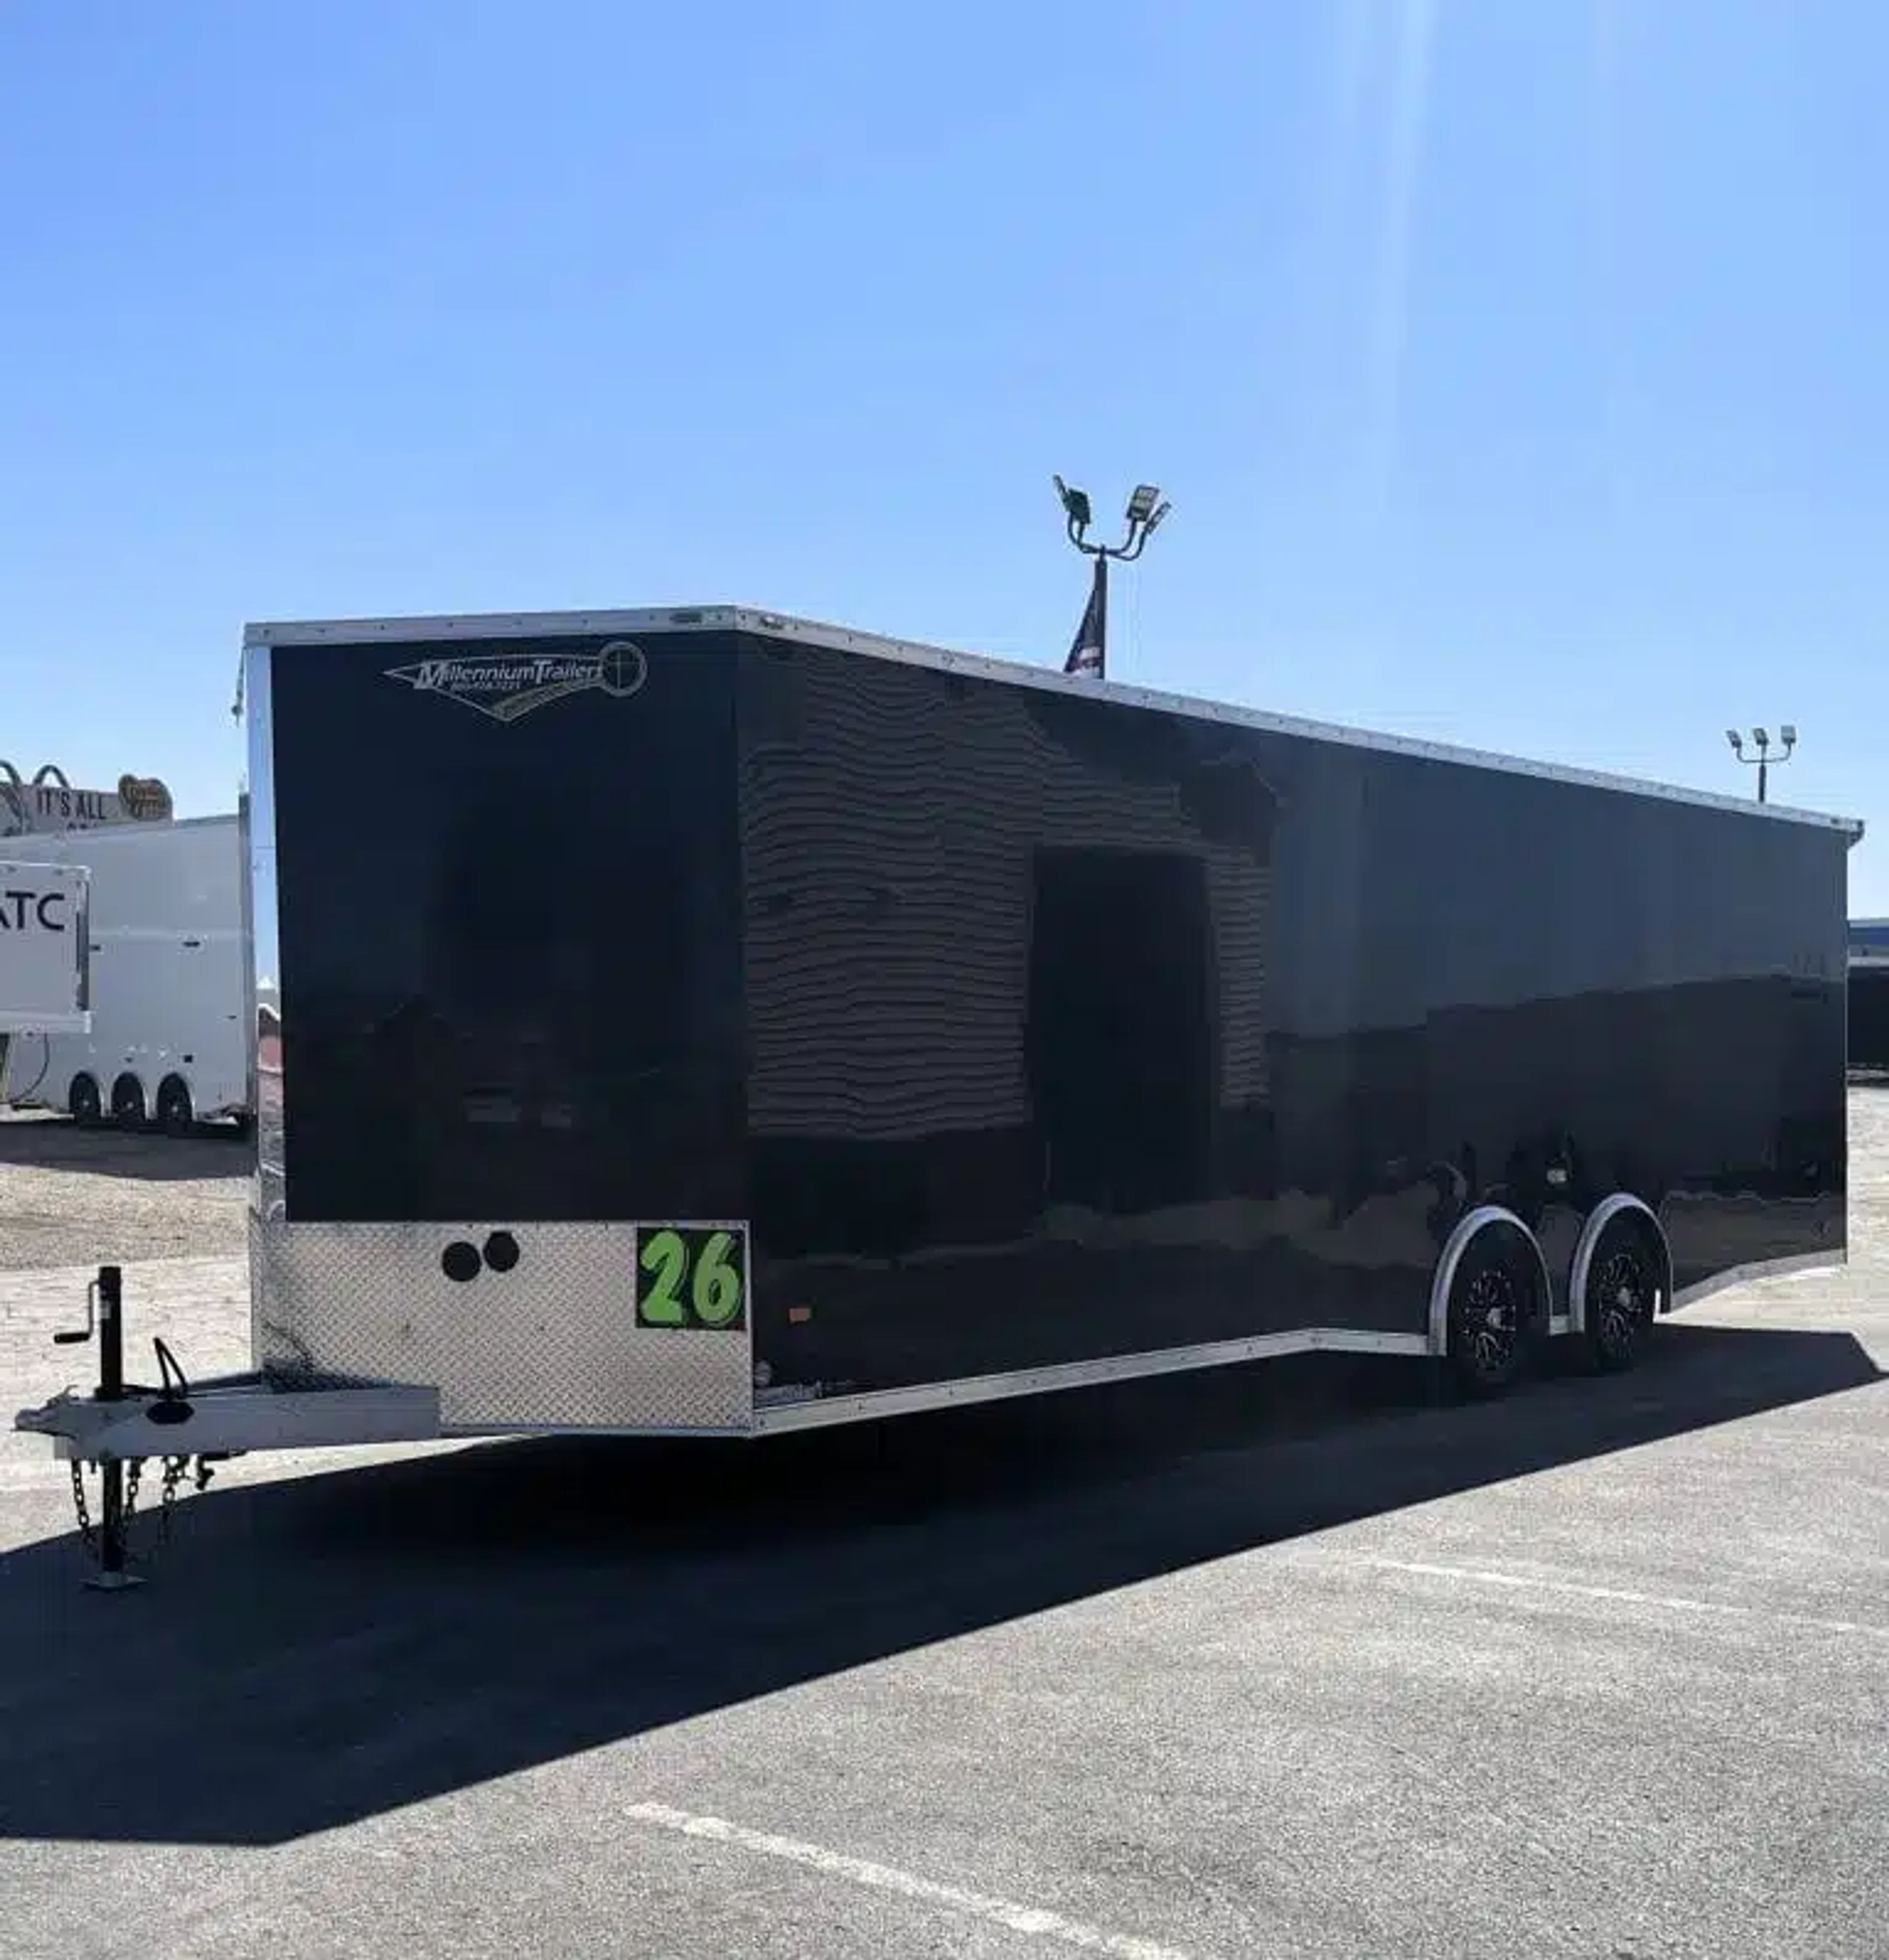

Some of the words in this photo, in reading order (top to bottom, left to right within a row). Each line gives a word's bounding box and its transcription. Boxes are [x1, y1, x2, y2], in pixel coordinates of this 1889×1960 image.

[37, 789, 70, 817] IT'S
[76, 792, 106, 820] ALL
[640, 1231, 739, 1325] 26
